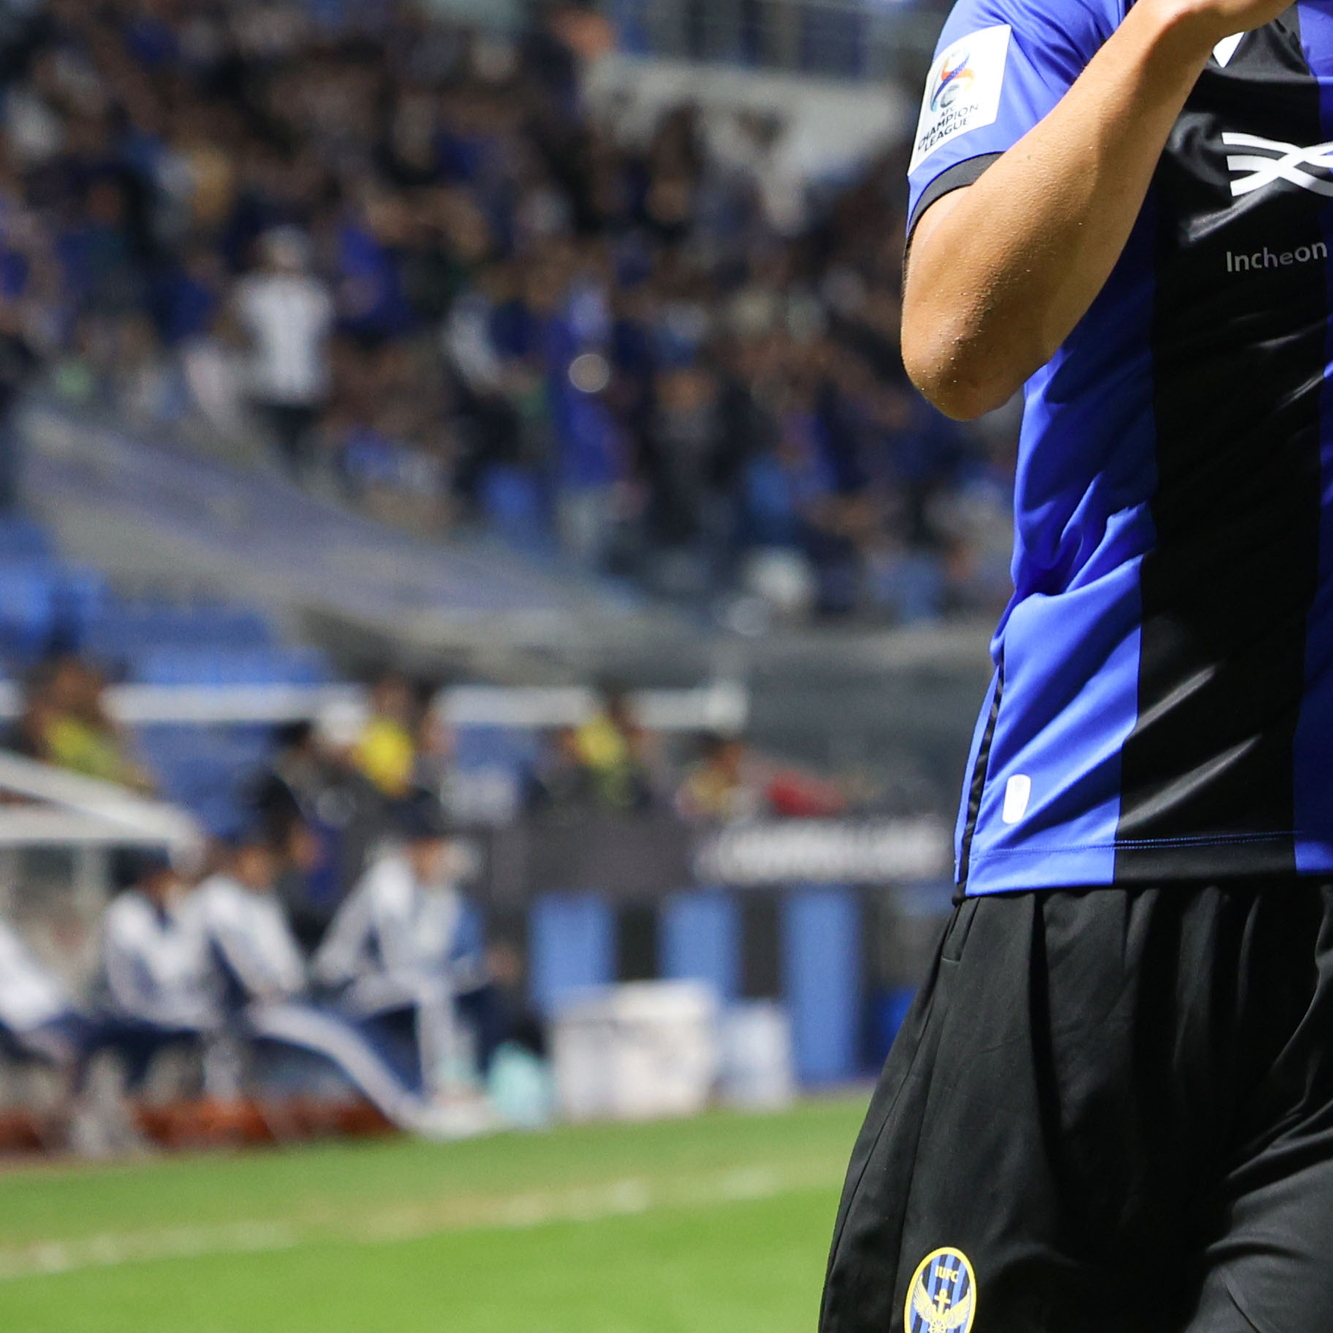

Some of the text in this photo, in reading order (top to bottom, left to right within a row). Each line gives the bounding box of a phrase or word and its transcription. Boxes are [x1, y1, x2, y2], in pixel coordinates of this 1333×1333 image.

[918, 104, 978, 150] CHAMPION
[924, 117, 969, 152] LEAGUE
[1226, 241, 1328, 272] Incheon
[934, 1265, 959, 1283] IUFC
